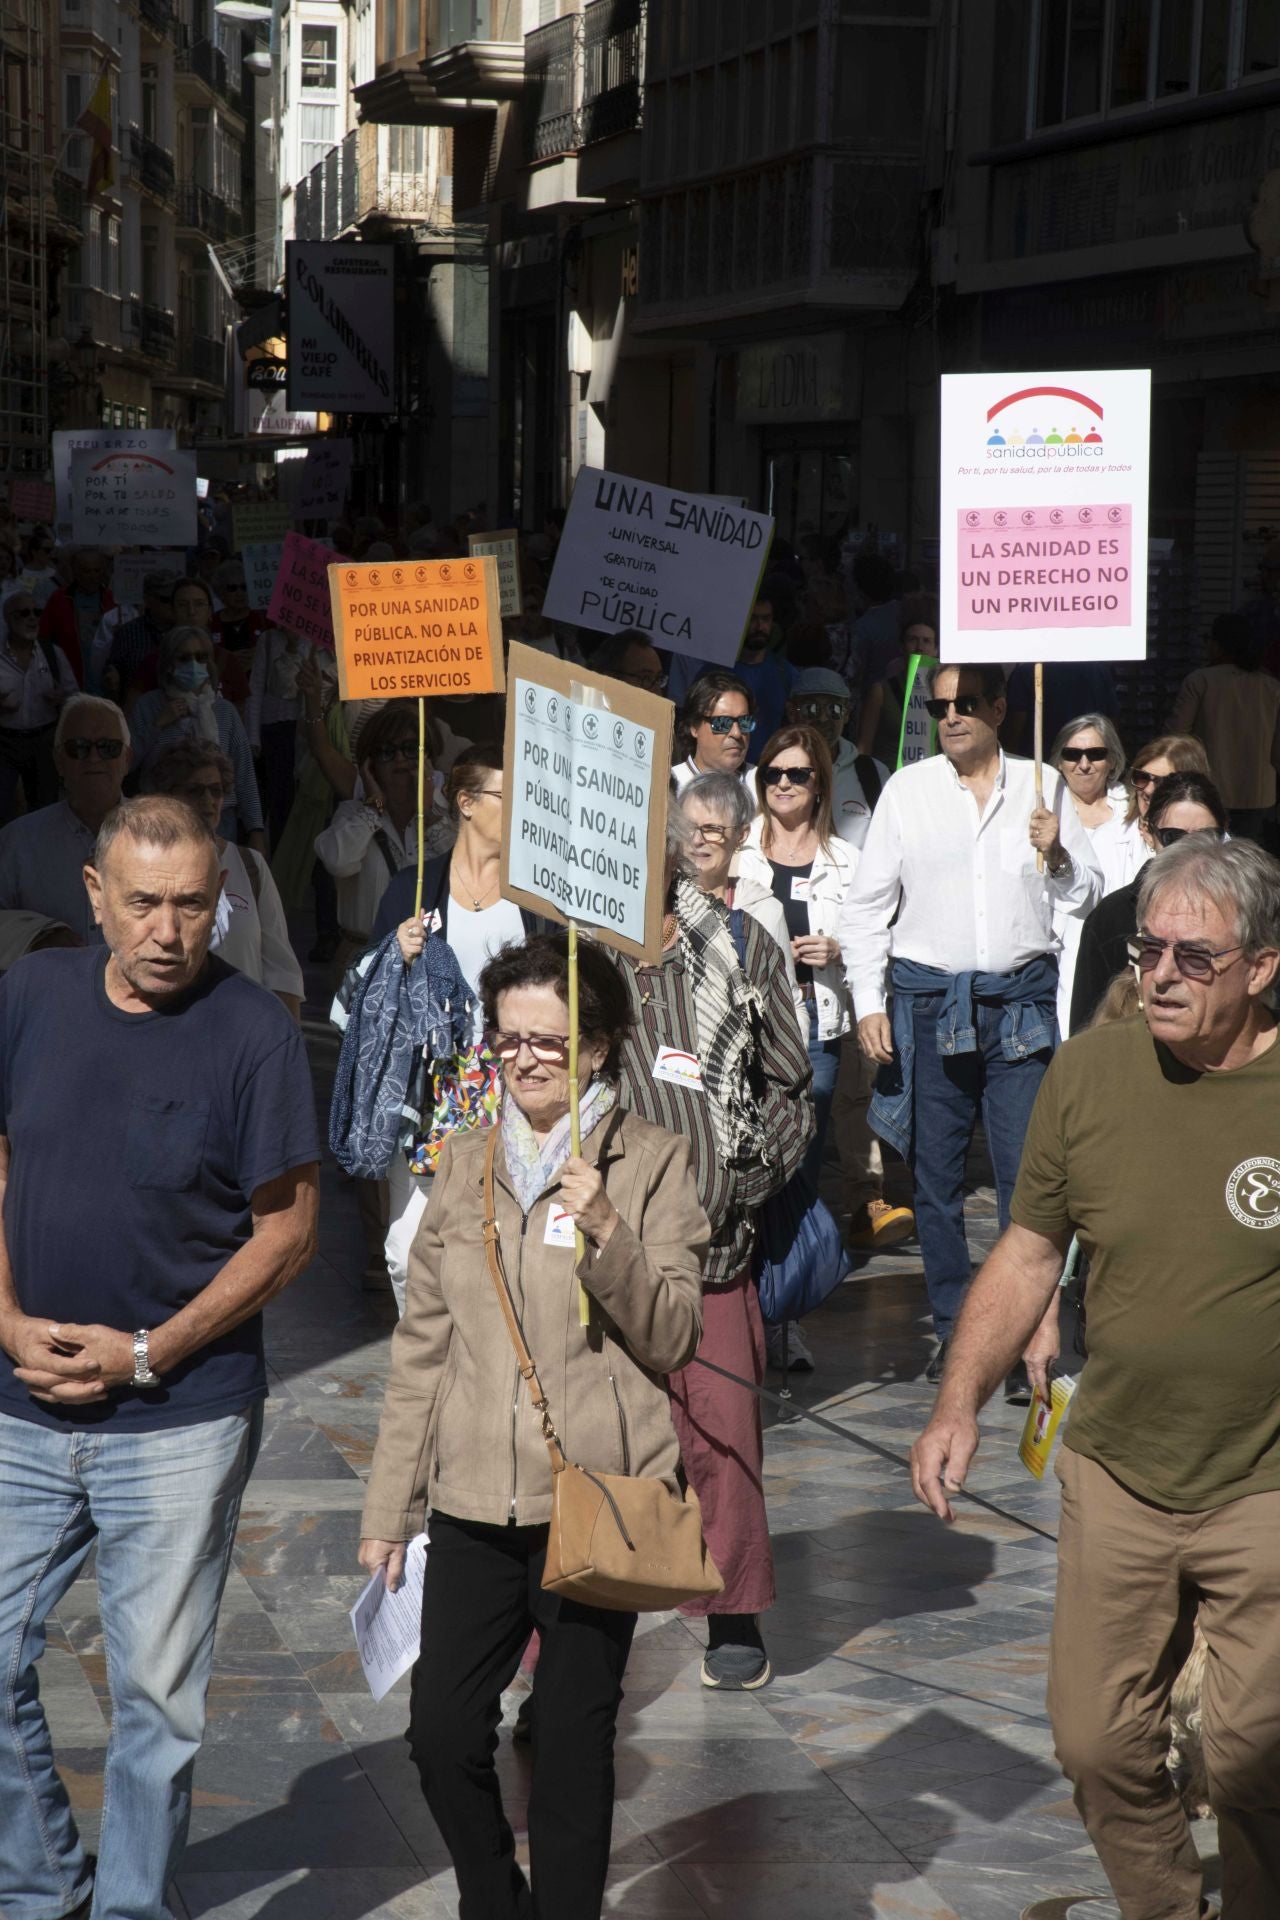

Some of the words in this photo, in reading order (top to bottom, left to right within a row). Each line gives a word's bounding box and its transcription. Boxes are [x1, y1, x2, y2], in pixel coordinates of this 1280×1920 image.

[324, 266, 388, 276] RESTAURANTE
[302, 338, 317, 349] MI
[302, 352, 338, 364] VIEJO
[986, 443, 1103, 459] sanidadpública
[957, 467, 974, 475] Por
[983, 467, 998, 476] por
[999, 466, 1008, 474] tu
[1037, 467, 1053, 475] por
[1054, 465, 1062, 473] la
[1064, 465, 1075, 473] de
[1076, 465, 1100, 473] todas
[1108, 464, 1132, 472] todos
[86, 477, 109, 487] POR
[85, 490, 106, 500] POR
[595, 478, 654, 520] UNA
[665, 498, 763, 549] SANIDAD
[971, 542, 995, 559] LA
[1000, 540, 1091, 558] SANIDAD
[1098, 539, 1119, 555] ES
[254, 561, 269, 573] LA
[271, 561, 279, 571] S
[291, 561, 306, 580] LA
[961, 571, 990, 587] UN
[998, 567, 1091, 586] DERECHO
[1097, 566, 1129, 583] NO
[254, 578, 273, 589] NO
[617, 581, 658, 598] CALIDAD
[283, 582, 302, 602] NO
[304, 595, 321, 612] SE
[322, 602, 331, 617] V
[350, 602, 377, 617] POR
[381, 600, 411, 616] UNA
[415, 596, 479, 614] SANIDAD
[971, 598, 1001, 614] UN
[1008, 594, 1119, 613] PRIVILEGIO
[278, 606, 295, 624] SE
[296, 615, 332, 645] DEFIE
[580, 591, 692, 640] PÚBLICA
[355, 624, 417, 642] PÚBLICA.
[421, 623, 442, 638] NO
[447, 623, 456, 637] A
[460, 622, 478, 636] LA
[354, 645, 460, 667] PRIVATIZACIÓN
[465, 646, 483, 661] DE
[370, 676, 397, 691] LOS
[400, 672, 471, 689] SERVICIOS
[523, 740, 549, 772] POR
[576, 765, 644, 808] SANIDAD
[580, 806, 606, 834] NO
[608, 817, 618, 841] A
[621, 824, 637, 849] LA
[533, 863, 556, 893] LOS
[622, 863, 640, 891] DE
[1233, 1159, 1275, 1179] CALIFORNIA
[1228, 1183, 1257, 1226] SACRAMENTO
